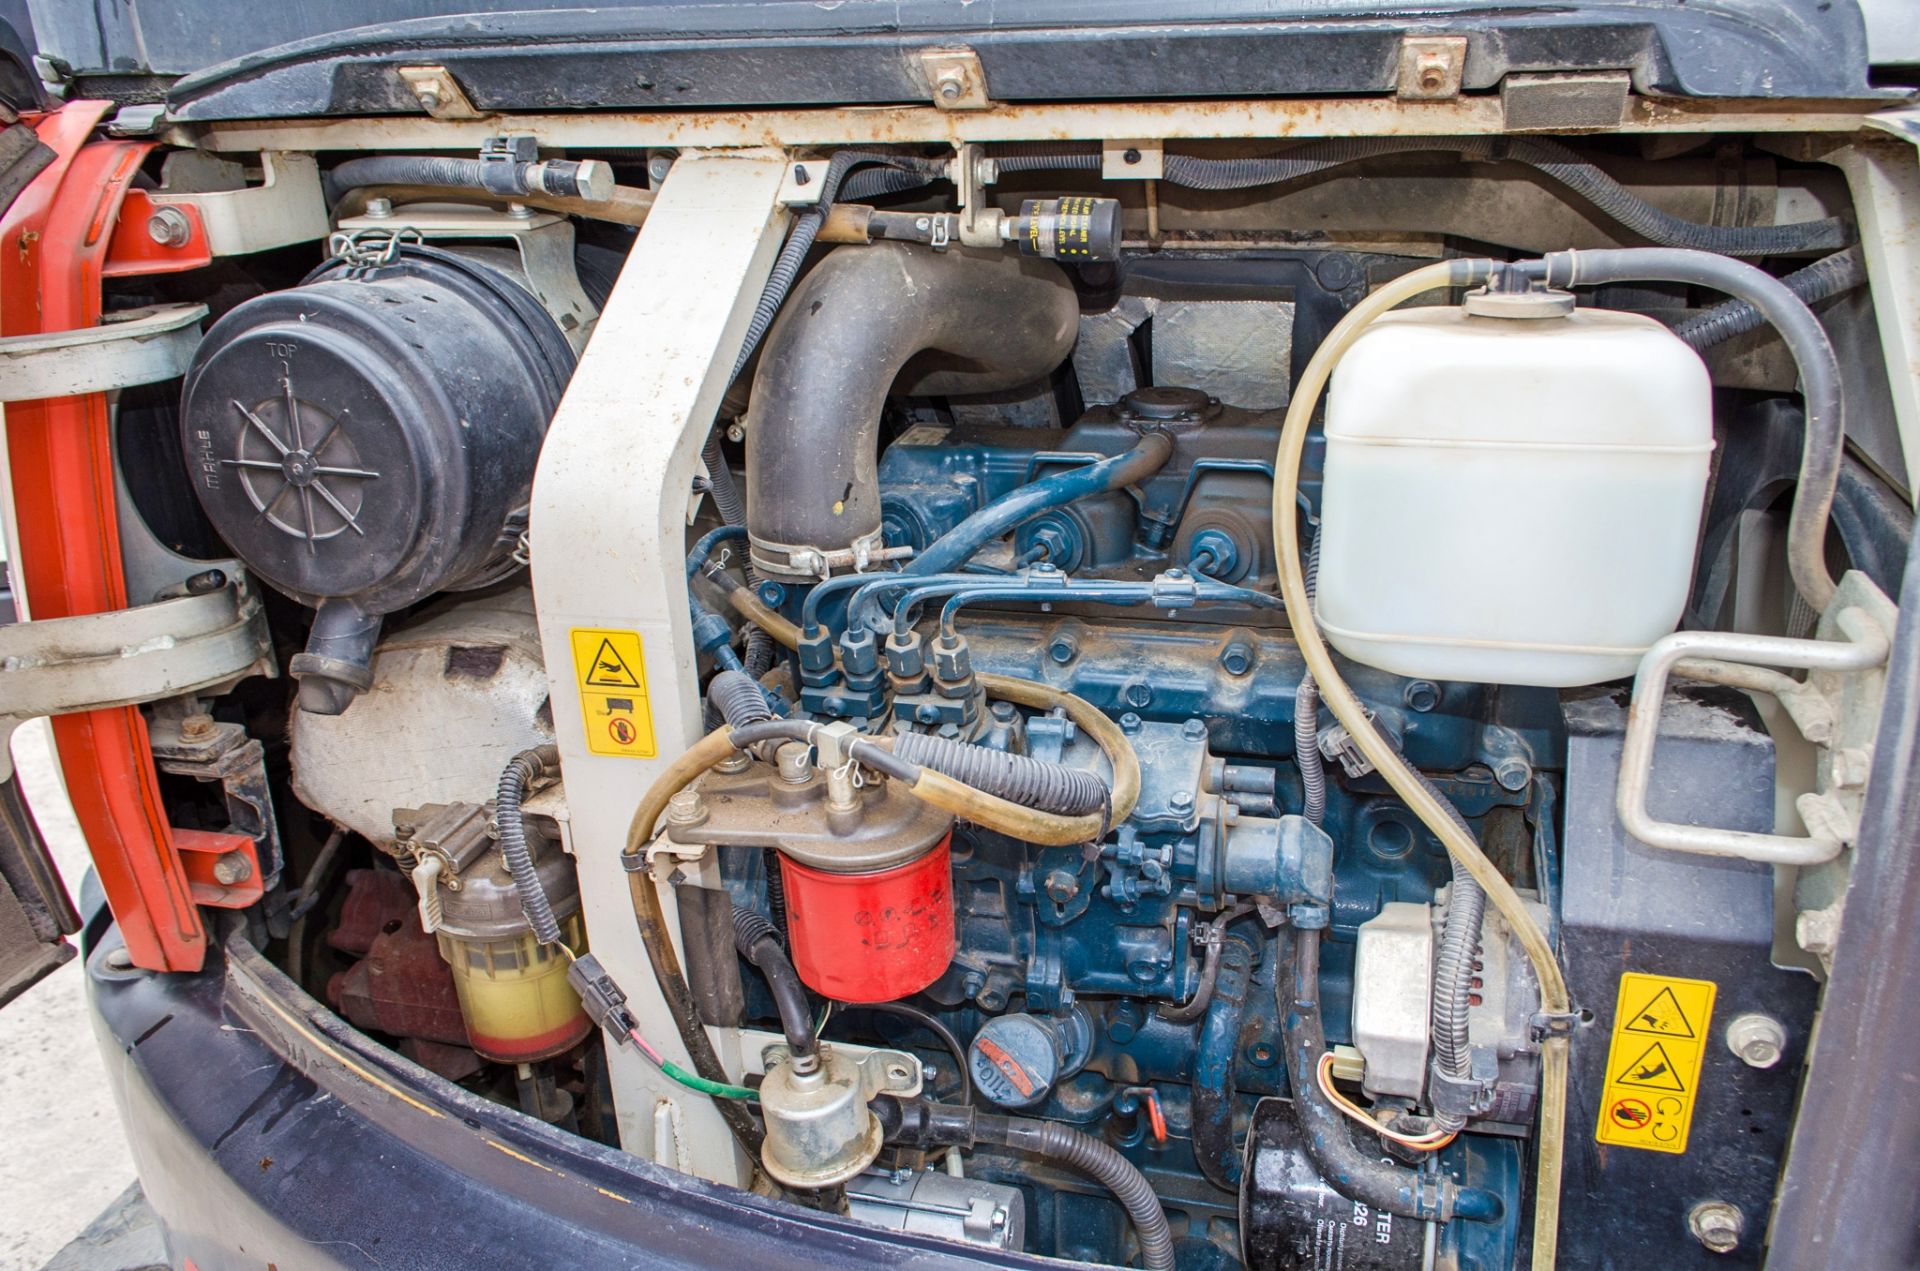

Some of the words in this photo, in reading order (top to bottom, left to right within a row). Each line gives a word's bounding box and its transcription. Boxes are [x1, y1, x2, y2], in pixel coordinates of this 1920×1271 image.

[1030, 216, 1039, 239] LEVEL
[265, 342, 298, 359] TOP
[198, 430, 220, 490] MAHLE
[1375, 1208, 1392, 1244] TER
